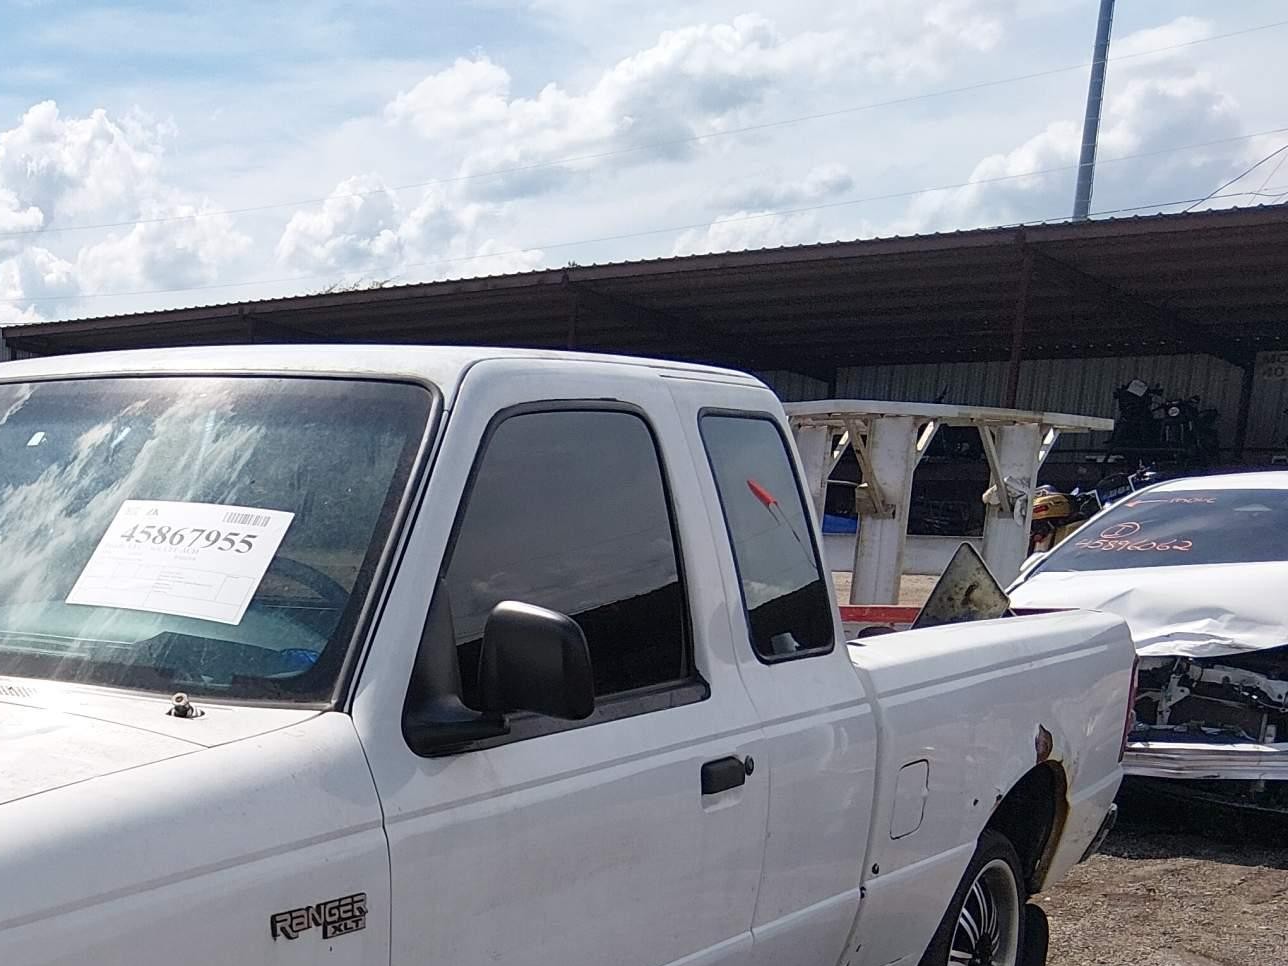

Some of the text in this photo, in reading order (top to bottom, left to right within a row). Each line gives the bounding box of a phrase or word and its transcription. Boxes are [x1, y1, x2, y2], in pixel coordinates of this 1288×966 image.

[120, 523, 259, 554] 45867955
[270, 892, 368, 941] RANGER
[329, 917, 365, 937] XLT
